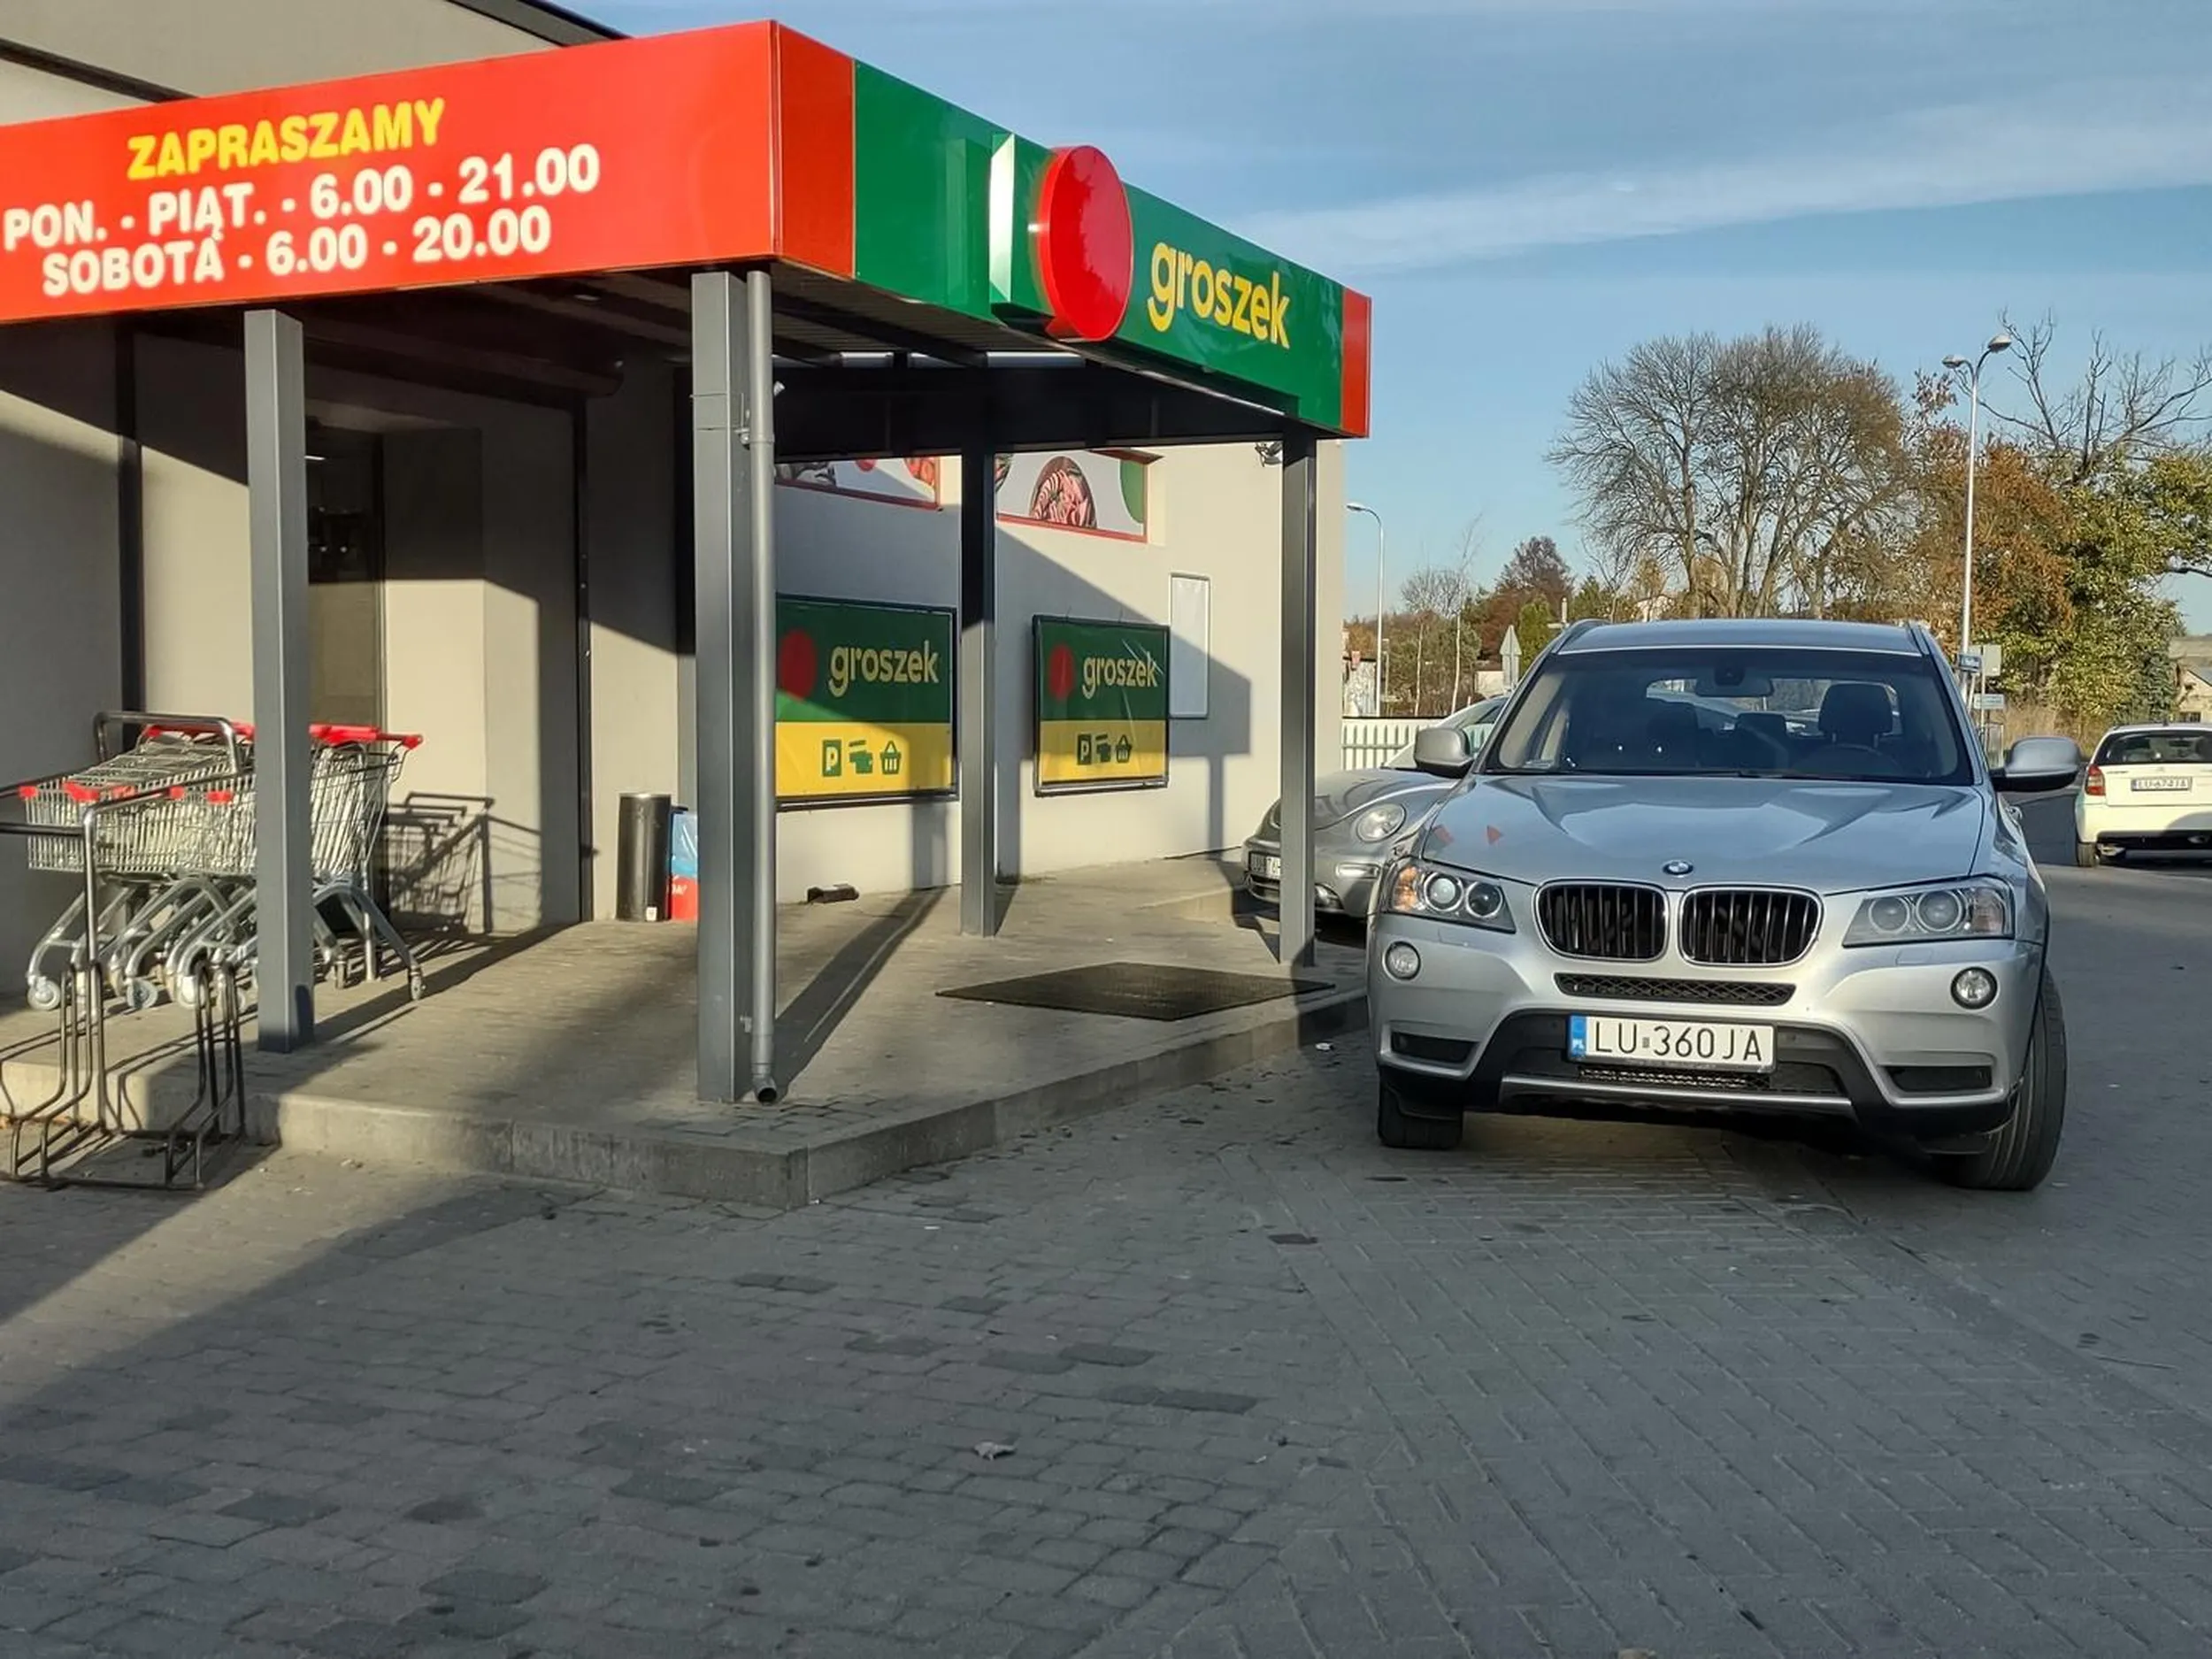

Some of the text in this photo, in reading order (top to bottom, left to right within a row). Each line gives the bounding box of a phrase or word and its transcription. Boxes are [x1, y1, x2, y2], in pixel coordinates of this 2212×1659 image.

[127, 97, 445, 180] ZAPRASZAMY
[4, 200, 107, 252] PON.
[149, 182, 266, 243] PIĄT.
[310, 165, 413, 220] 6.00
[458, 143, 601, 204] 21.00
[42, 237, 224, 297] SOBOTA
[265, 223, 368, 276] 6.00
[412, 204, 551, 263] 20.00
[1148, 242, 1291, 349] groszek
[827, 640, 940, 698] groszek
[1081, 650, 1158, 700] groszek
[1595, 1021, 1763, 1062] LU 360JA
